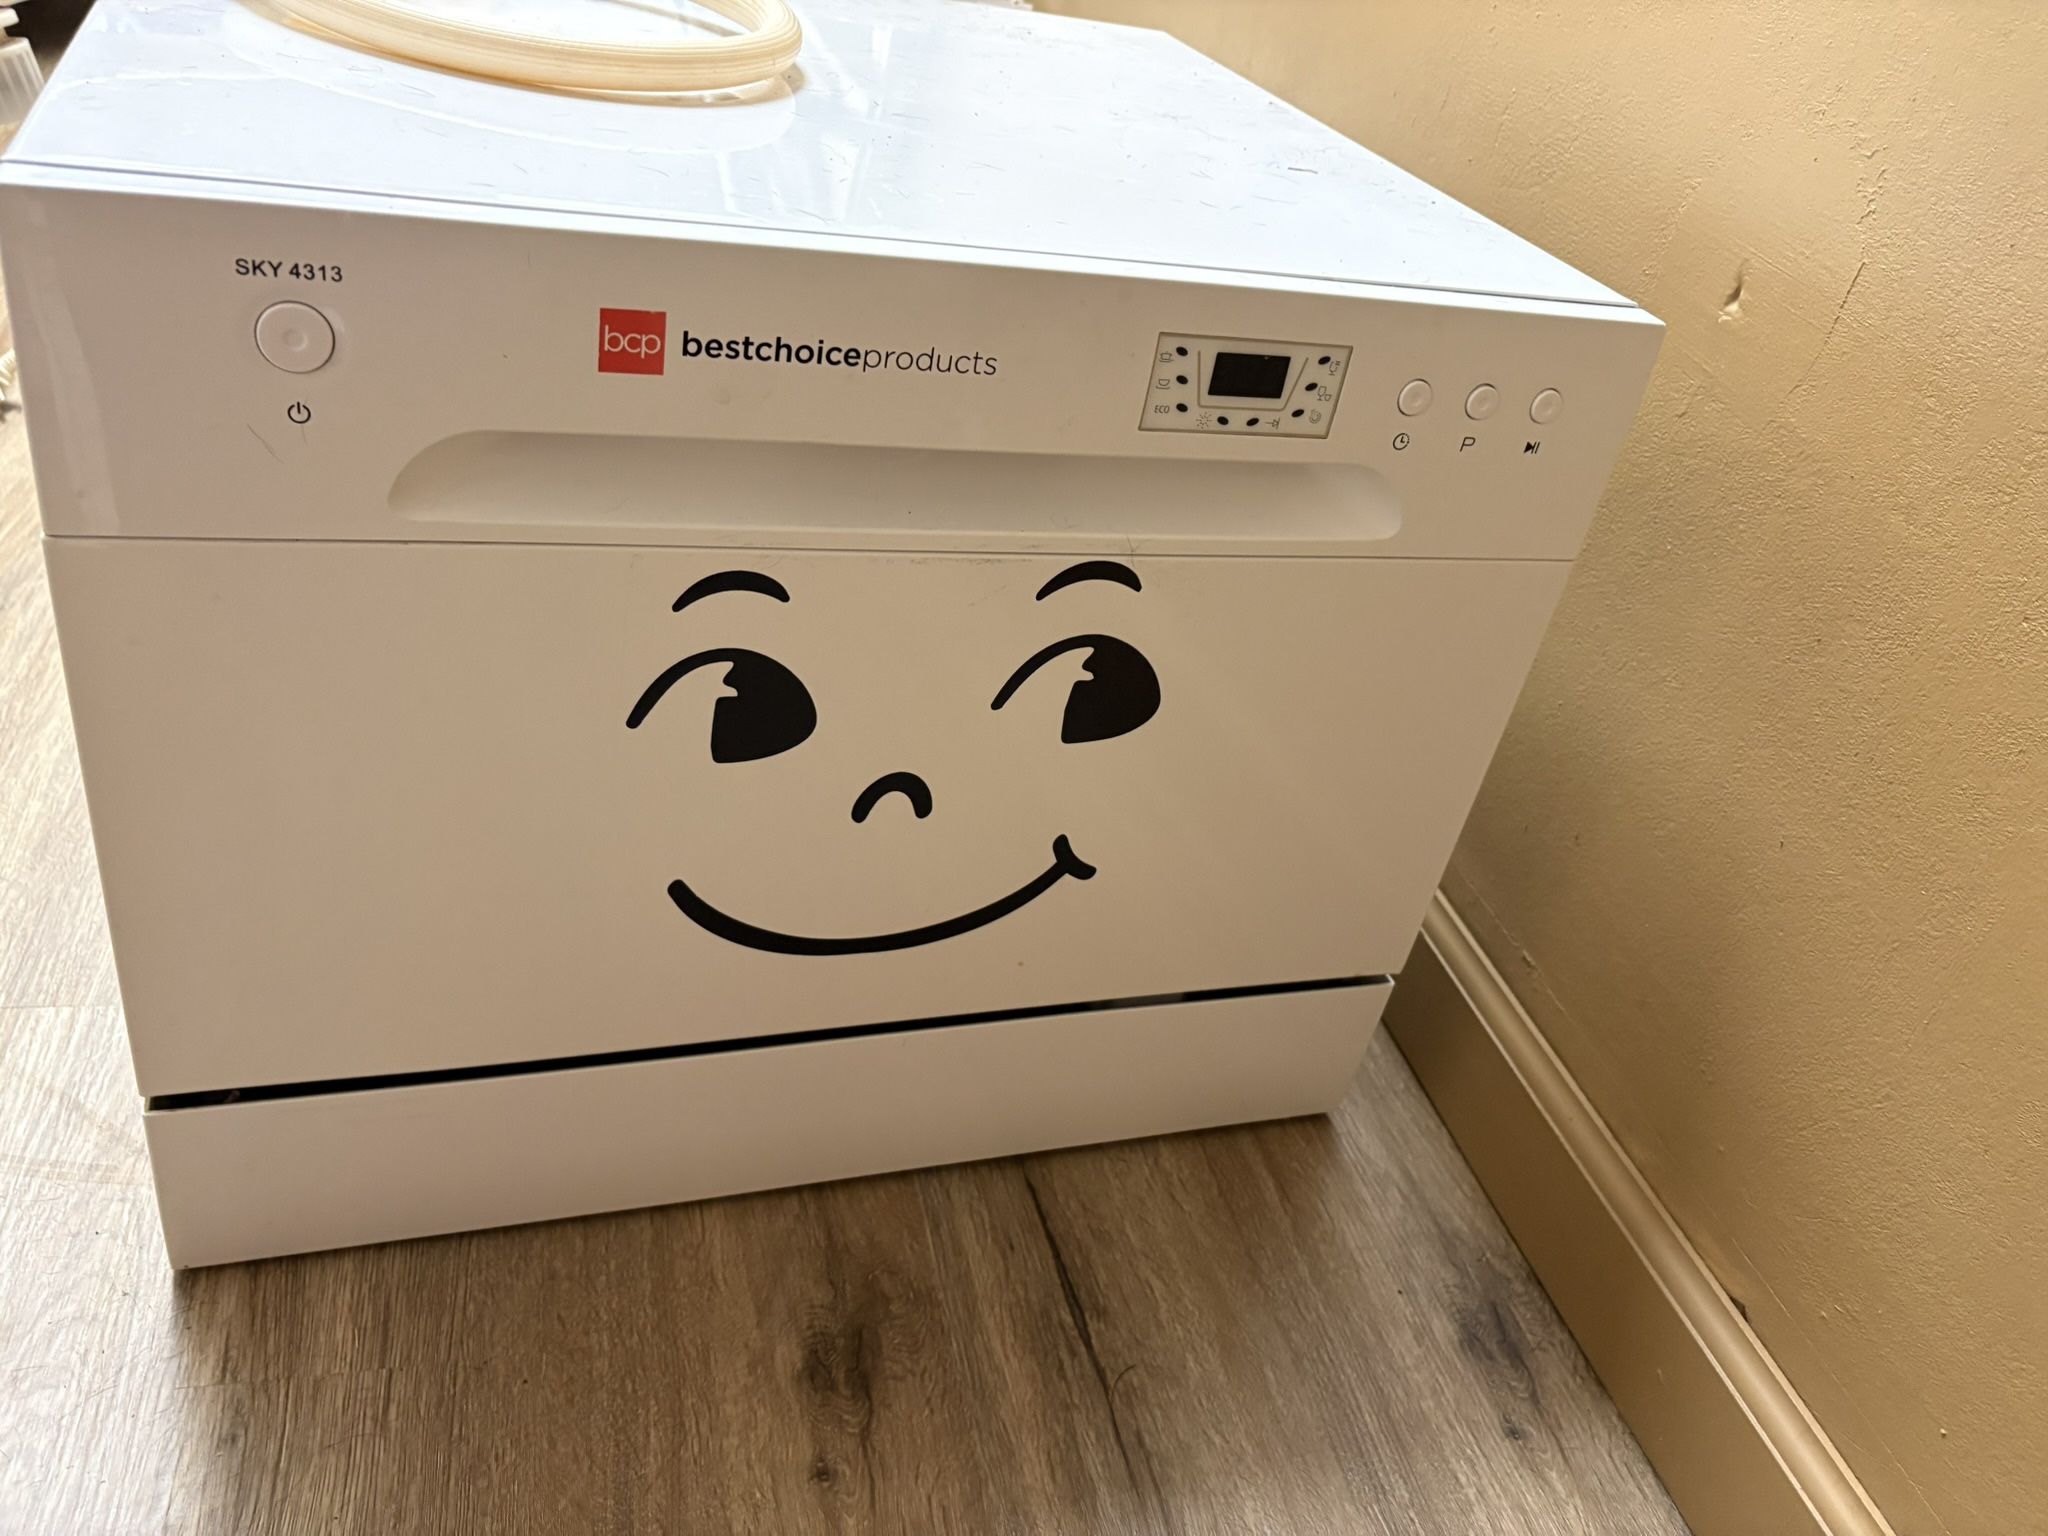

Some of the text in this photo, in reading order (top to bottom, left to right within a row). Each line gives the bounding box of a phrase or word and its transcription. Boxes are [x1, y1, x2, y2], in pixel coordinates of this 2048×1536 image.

[235, 258, 343, 283] SKY 4313
[603, 324, 662, 359] bcp
[1154, 404, 1170, 414] ECO
[1459, 436, 1476, 452] P
